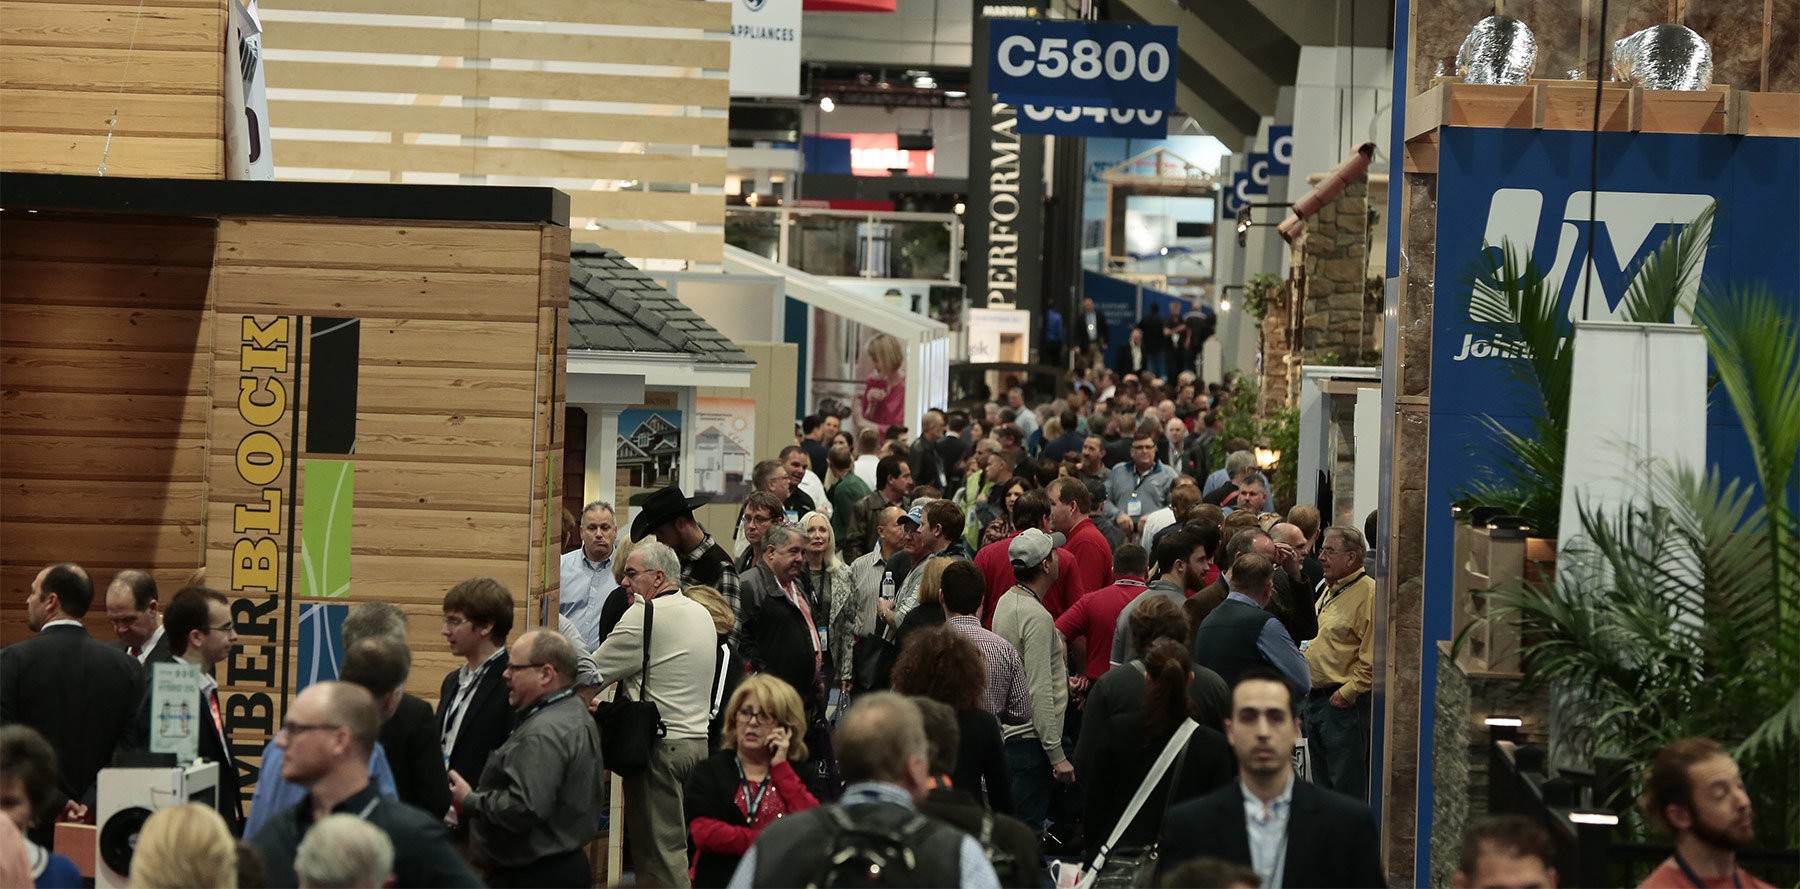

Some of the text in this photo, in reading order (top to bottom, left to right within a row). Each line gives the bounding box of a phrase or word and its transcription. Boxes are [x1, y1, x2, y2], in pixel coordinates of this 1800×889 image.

[983, 5, 1027, 17] MARVIN
[730, 25, 793, 41] APPLIANCES
[997, 35, 1170, 82] C5800
